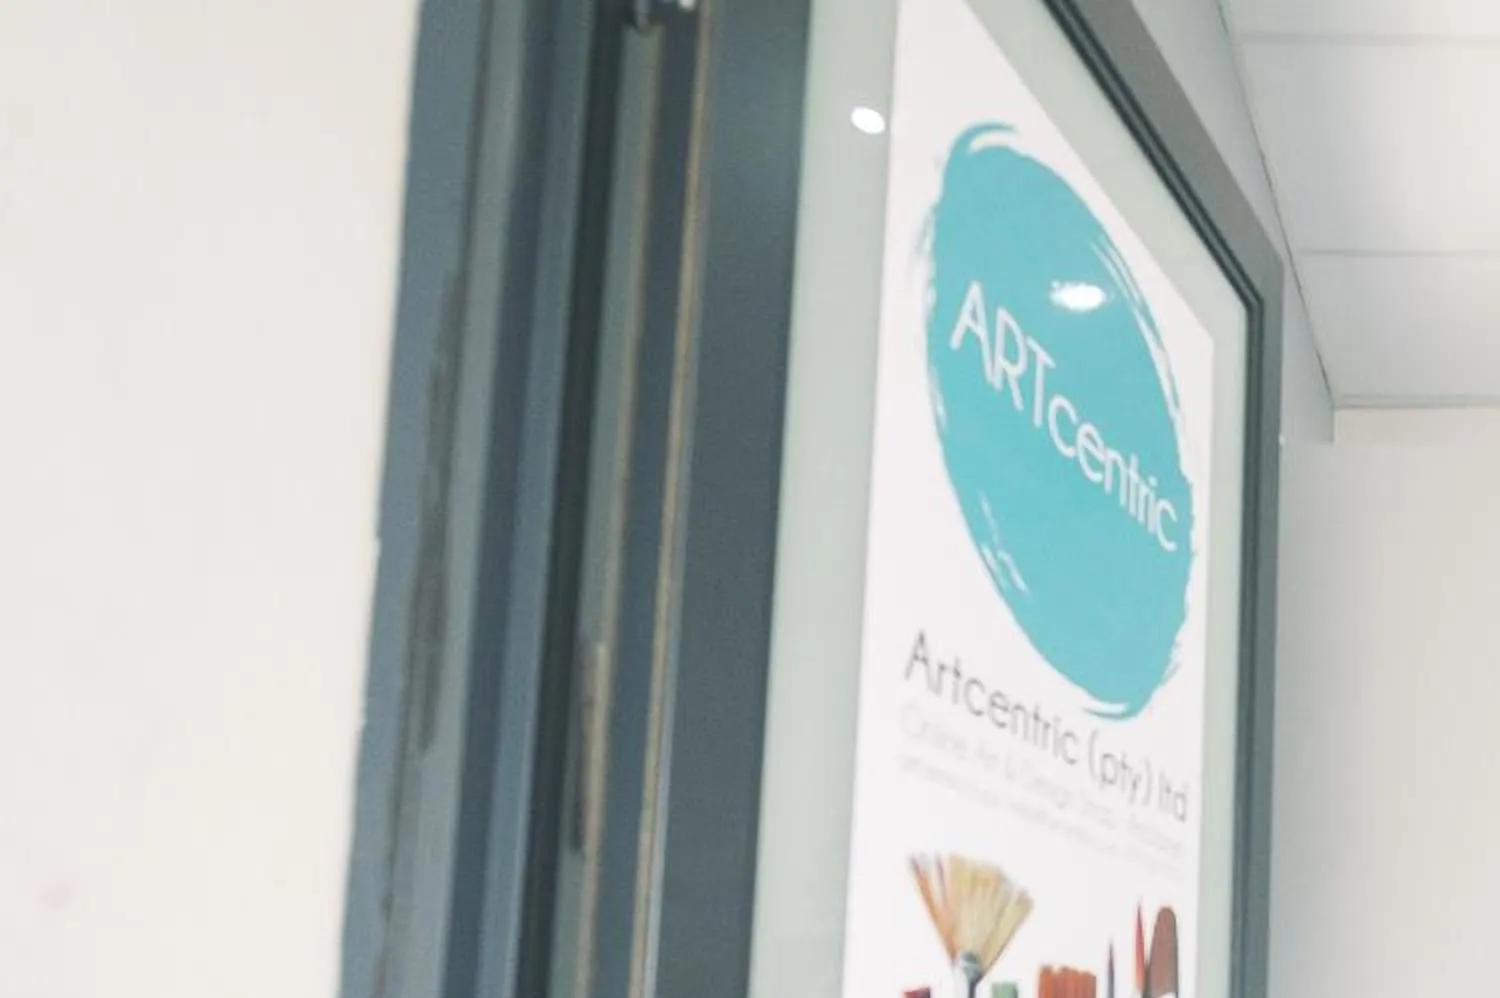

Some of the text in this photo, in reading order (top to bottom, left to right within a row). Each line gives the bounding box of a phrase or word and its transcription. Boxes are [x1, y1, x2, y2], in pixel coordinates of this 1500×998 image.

[949, 280, 1178, 552] ARTcentric
[904, 629, 1079, 766] Artcentric
[1087, 728, 1152, 807] (pty)
[1158, 769, 1188, 824] ltd
